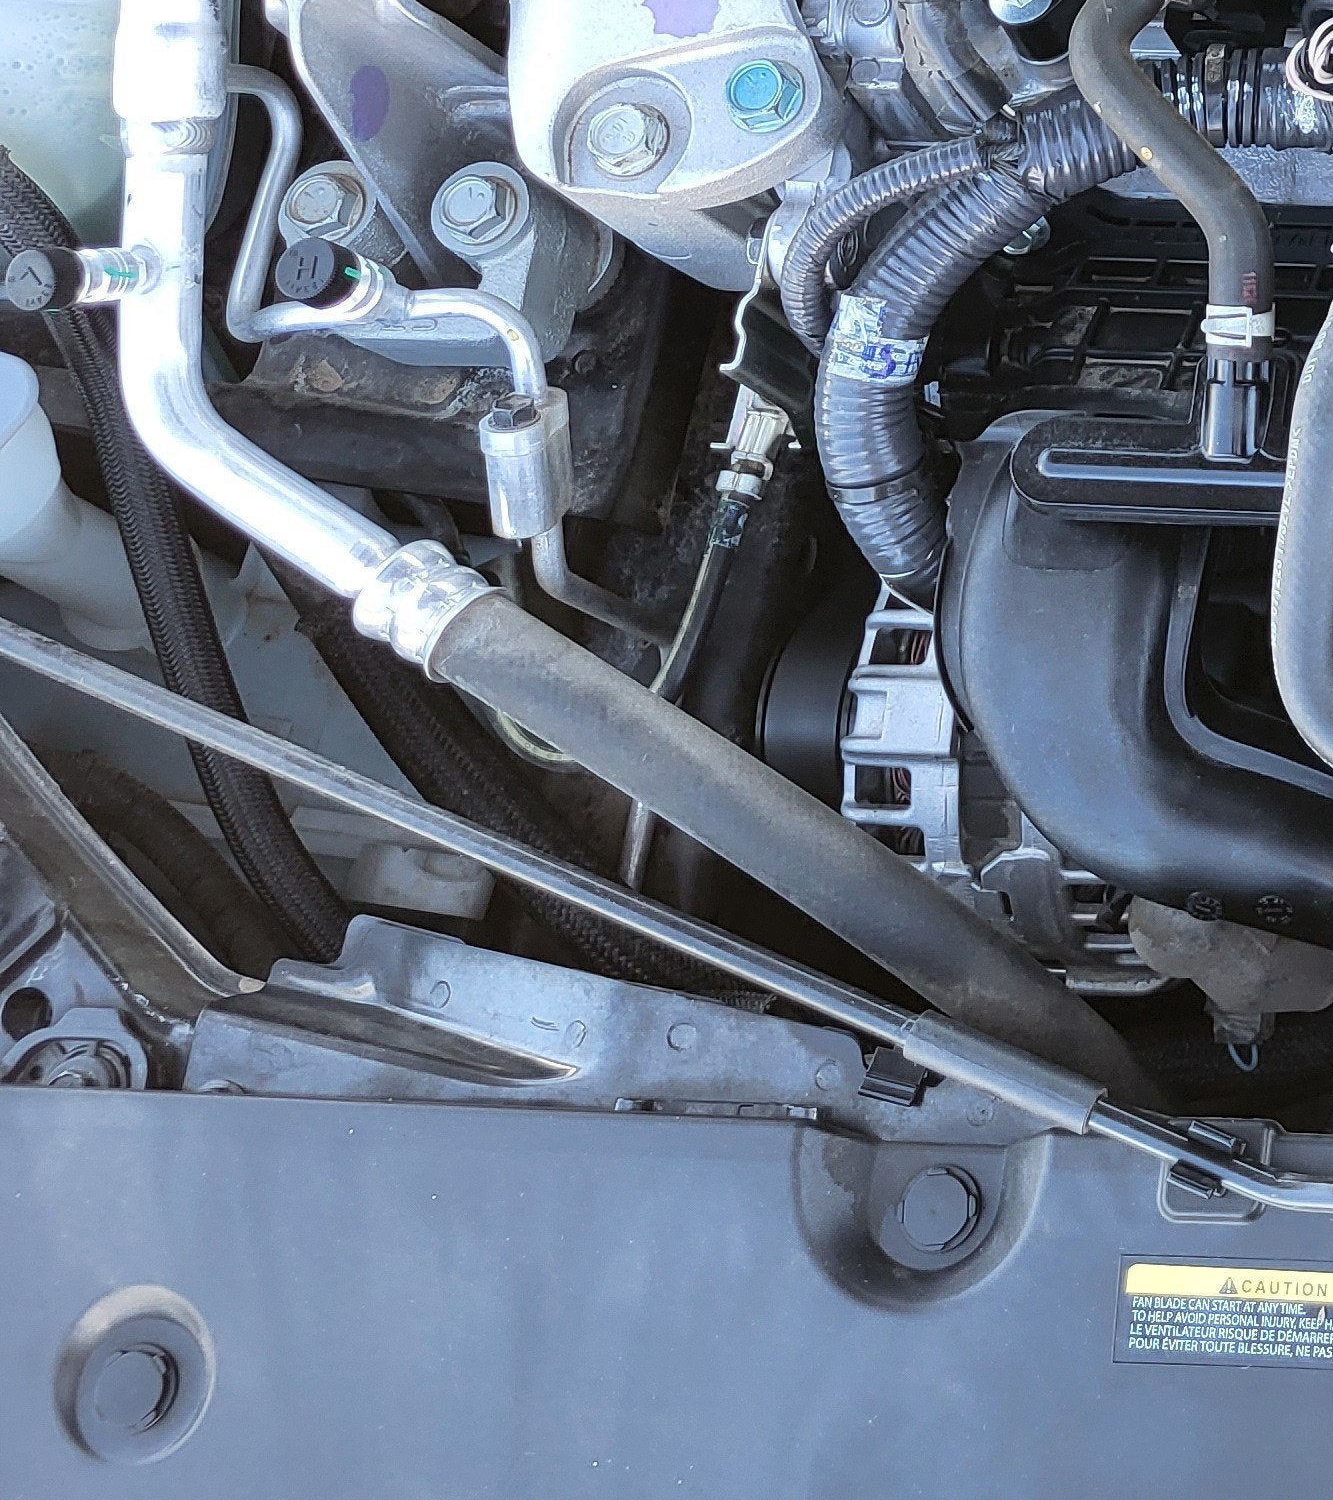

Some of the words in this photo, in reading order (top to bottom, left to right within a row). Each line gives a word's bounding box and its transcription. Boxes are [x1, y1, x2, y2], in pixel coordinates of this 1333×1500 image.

[1241, 1278, 1327, 1297] CAUTION
[1132, 1296, 1152, 1307] FAN
[1154, 1296, 1186, 1309] BLADE
[1188, 1298, 1209, 1310] CAN
[1211, 1299, 1241, 1312] START
[1242, 1301, 1255, 1312] AT
[1257, 1301, 1278, 1314] ANY
[1280, 1302, 1306, 1315] TIME.
[1131, 1309, 1146, 1321] TO
[1147, 1310, 1172, 1322] HELP
[1174, 1311, 1205, 1324] AVOID
[1208, 1313, 1259, 1327] PERSONAL
[1261, 1316, 1296, 1330] INJURY,
[1298, 1317, 1324, 1330] KEEP
[1130, 1323, 1142, 1335] LE
[1143, 1324, 1218, 1339] VENTILATEUR
[1219, 1327, 1257, 1341] RISQUE
[1260, 1329, 1274, 1341] DE
[1129, 1337, 1159, 1350] POUR
[1161, 1336, 1198, 1351] ÉVITER
[1200, 1341, 1235, 1353] TOUTE
[1237, 1342, 1293, 1357] BLESSURE,
[1295, 1345, 1310, 1356] NE
[1313, 1346, 1332, 1357] PAS
